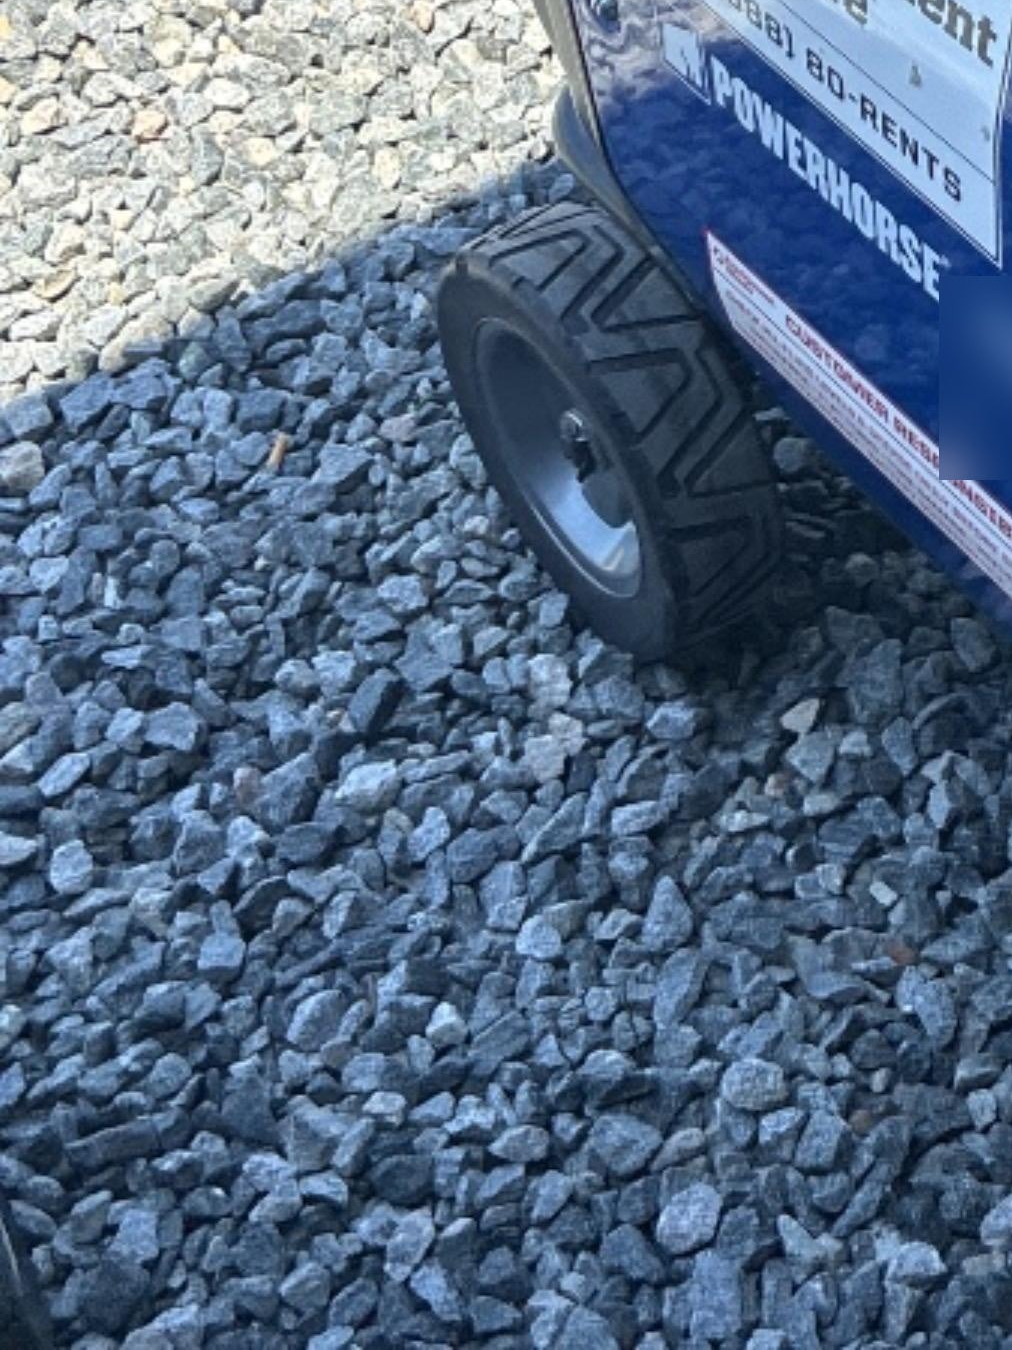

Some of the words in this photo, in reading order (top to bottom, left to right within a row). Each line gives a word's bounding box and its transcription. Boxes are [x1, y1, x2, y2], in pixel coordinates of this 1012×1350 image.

[709, 53, 940, 302] POWERHORSE
[806, 48, 962, 203] 80-RENTS
[785, 314, 890, 423] CUSTOMER
